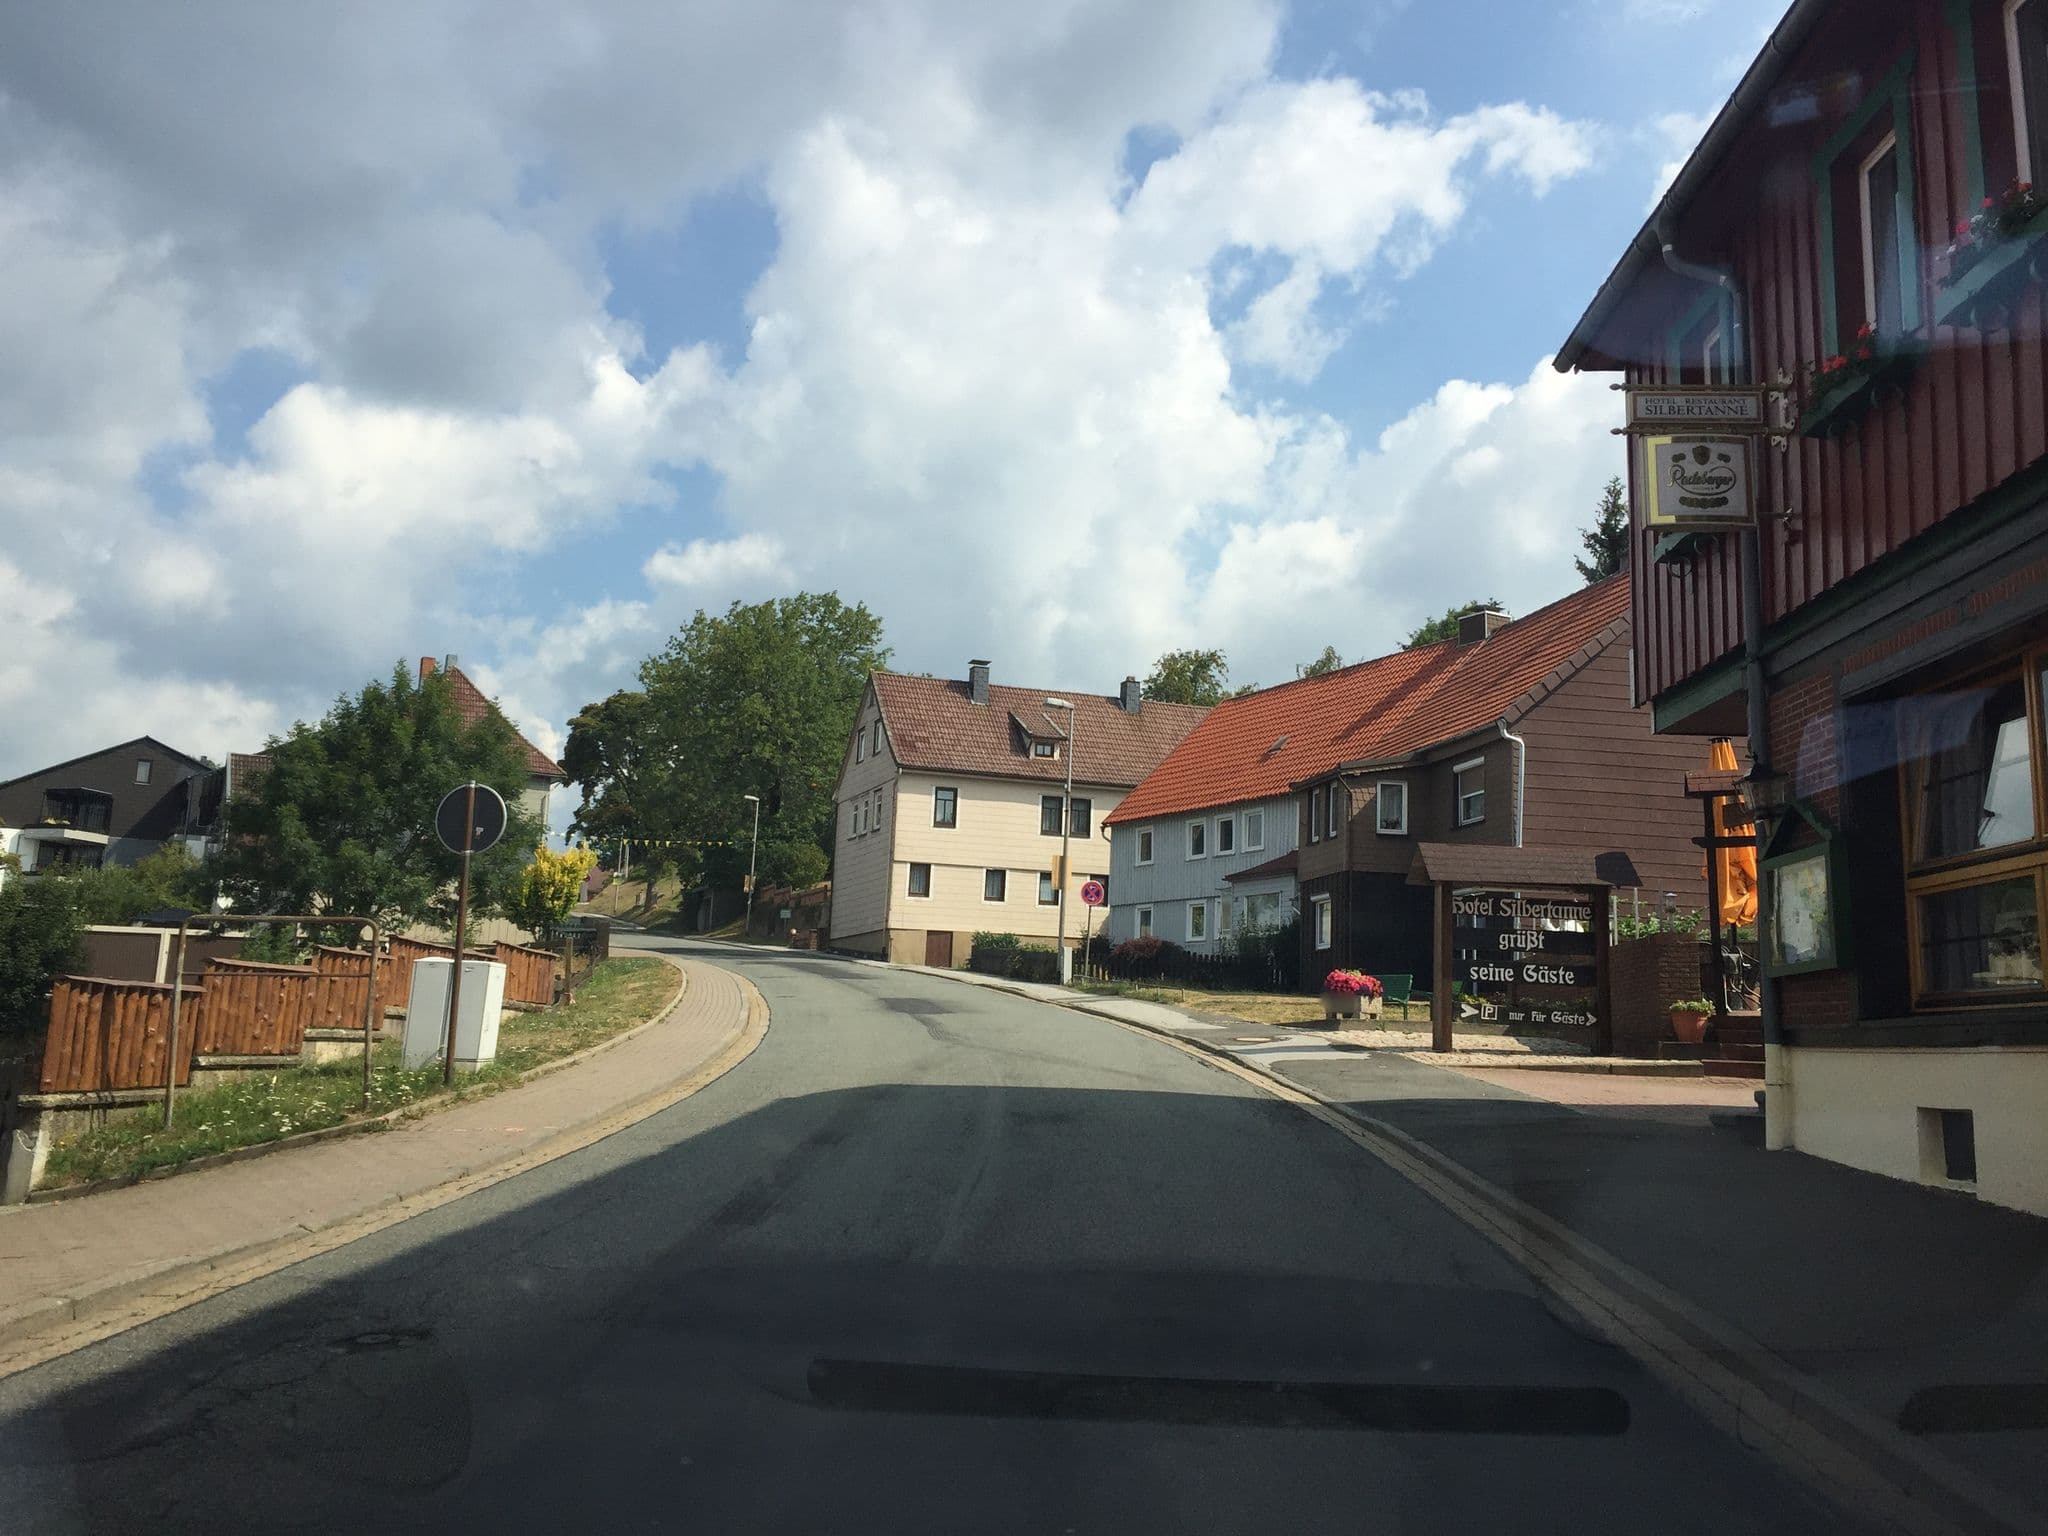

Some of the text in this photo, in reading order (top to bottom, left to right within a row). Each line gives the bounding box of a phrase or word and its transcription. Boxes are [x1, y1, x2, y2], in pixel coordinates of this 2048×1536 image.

[1645, 404, 1749, 416] SILBERTANNE
[1452, 897, 1593, 920] Hotel Silbertanne
[1499, 930, 1545, 952] grüßt
[1470, 963, 1576, 985] seine Gäste
[1508, 1011, 1525, 1021] nur
[1551, 1011, 1585, 1025] Gäste
